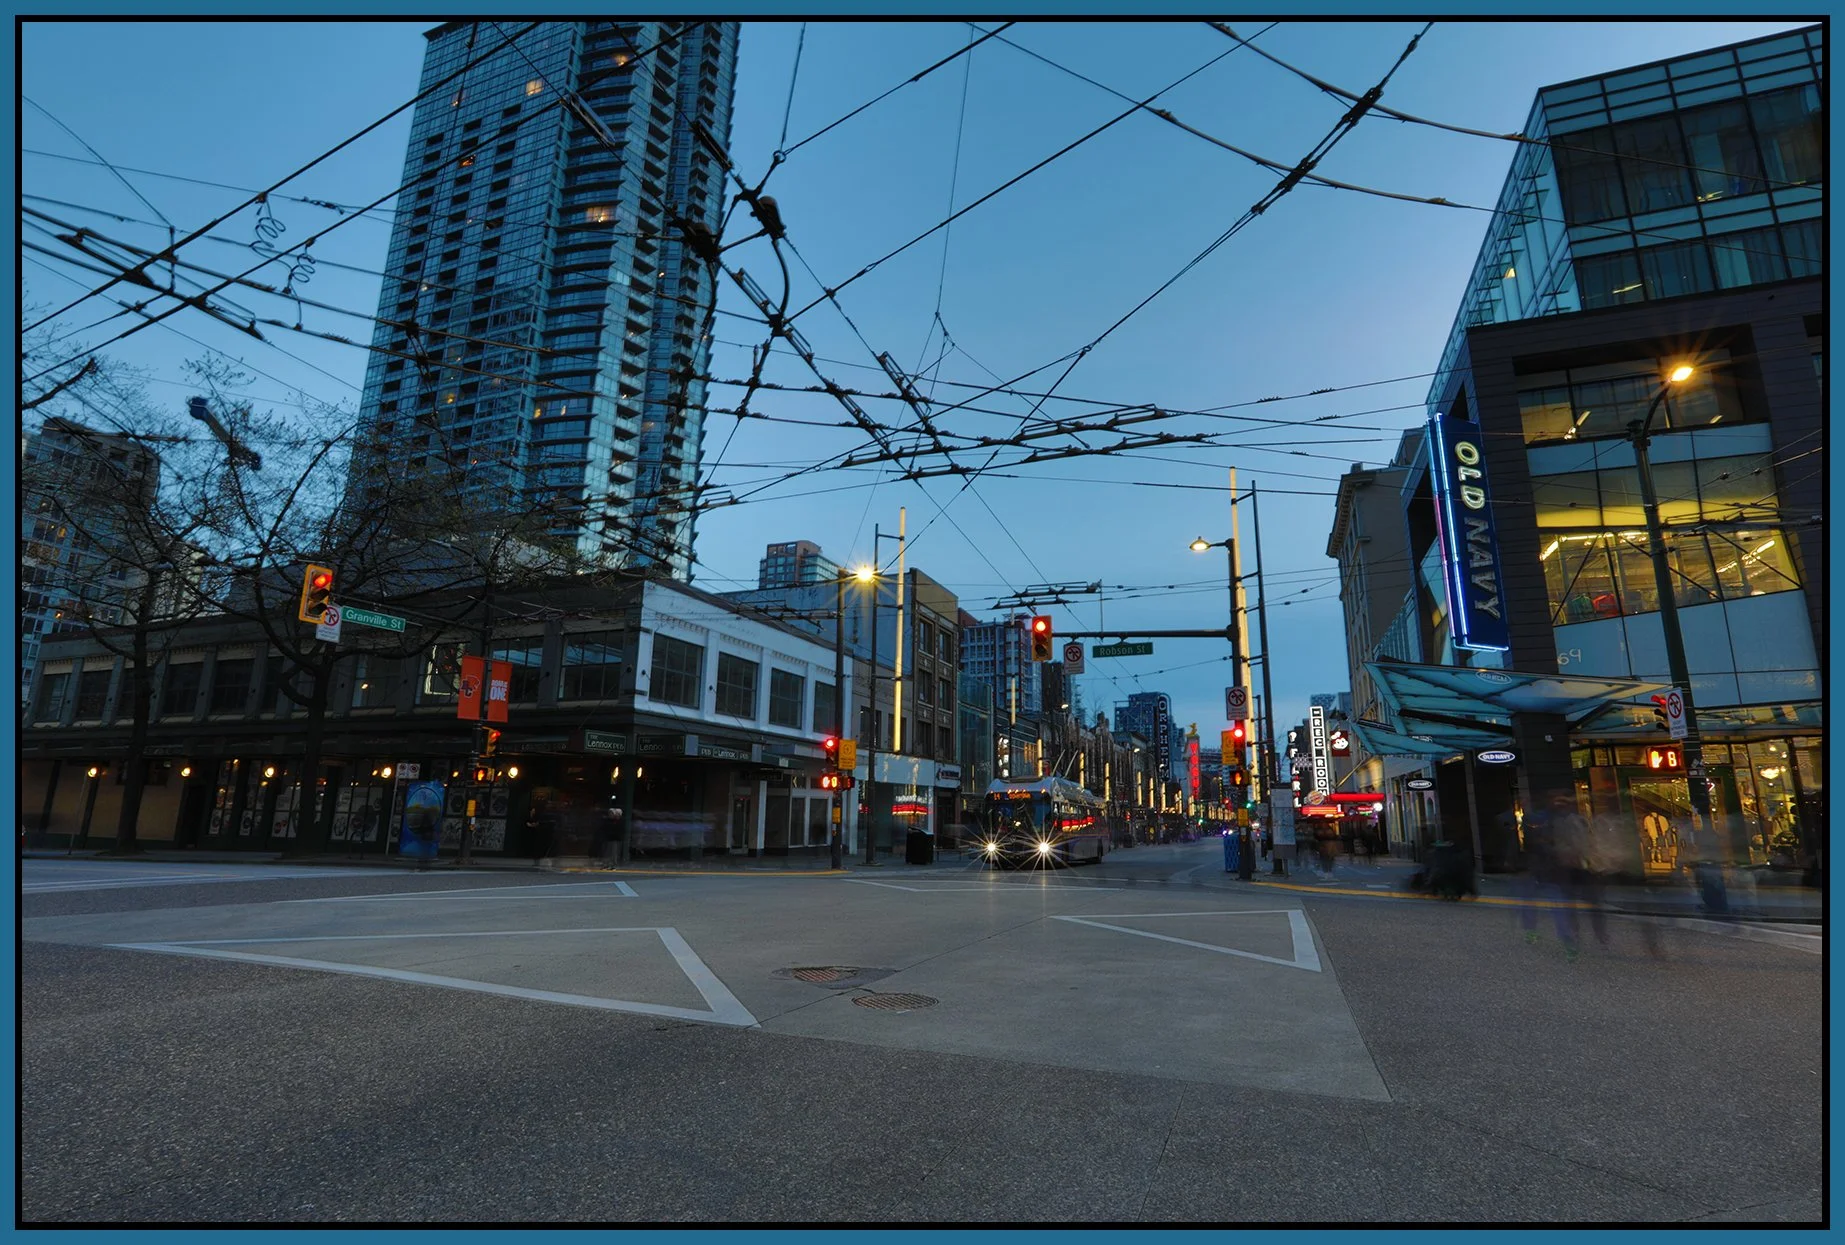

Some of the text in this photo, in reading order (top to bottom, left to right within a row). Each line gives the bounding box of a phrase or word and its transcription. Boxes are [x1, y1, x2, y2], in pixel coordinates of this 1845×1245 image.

[1454, 440, 1501, 619] OLD NAVY
[346, 609, 402, 630] Granville St
[1099, 644, 1146, 656] Robson St
[490, 687, 507, 701] ONE
[1314, 718, 1323, 747] REC
[587, 740, 612, 750] Lennox
[1668, 751, 1677, 767] 8
